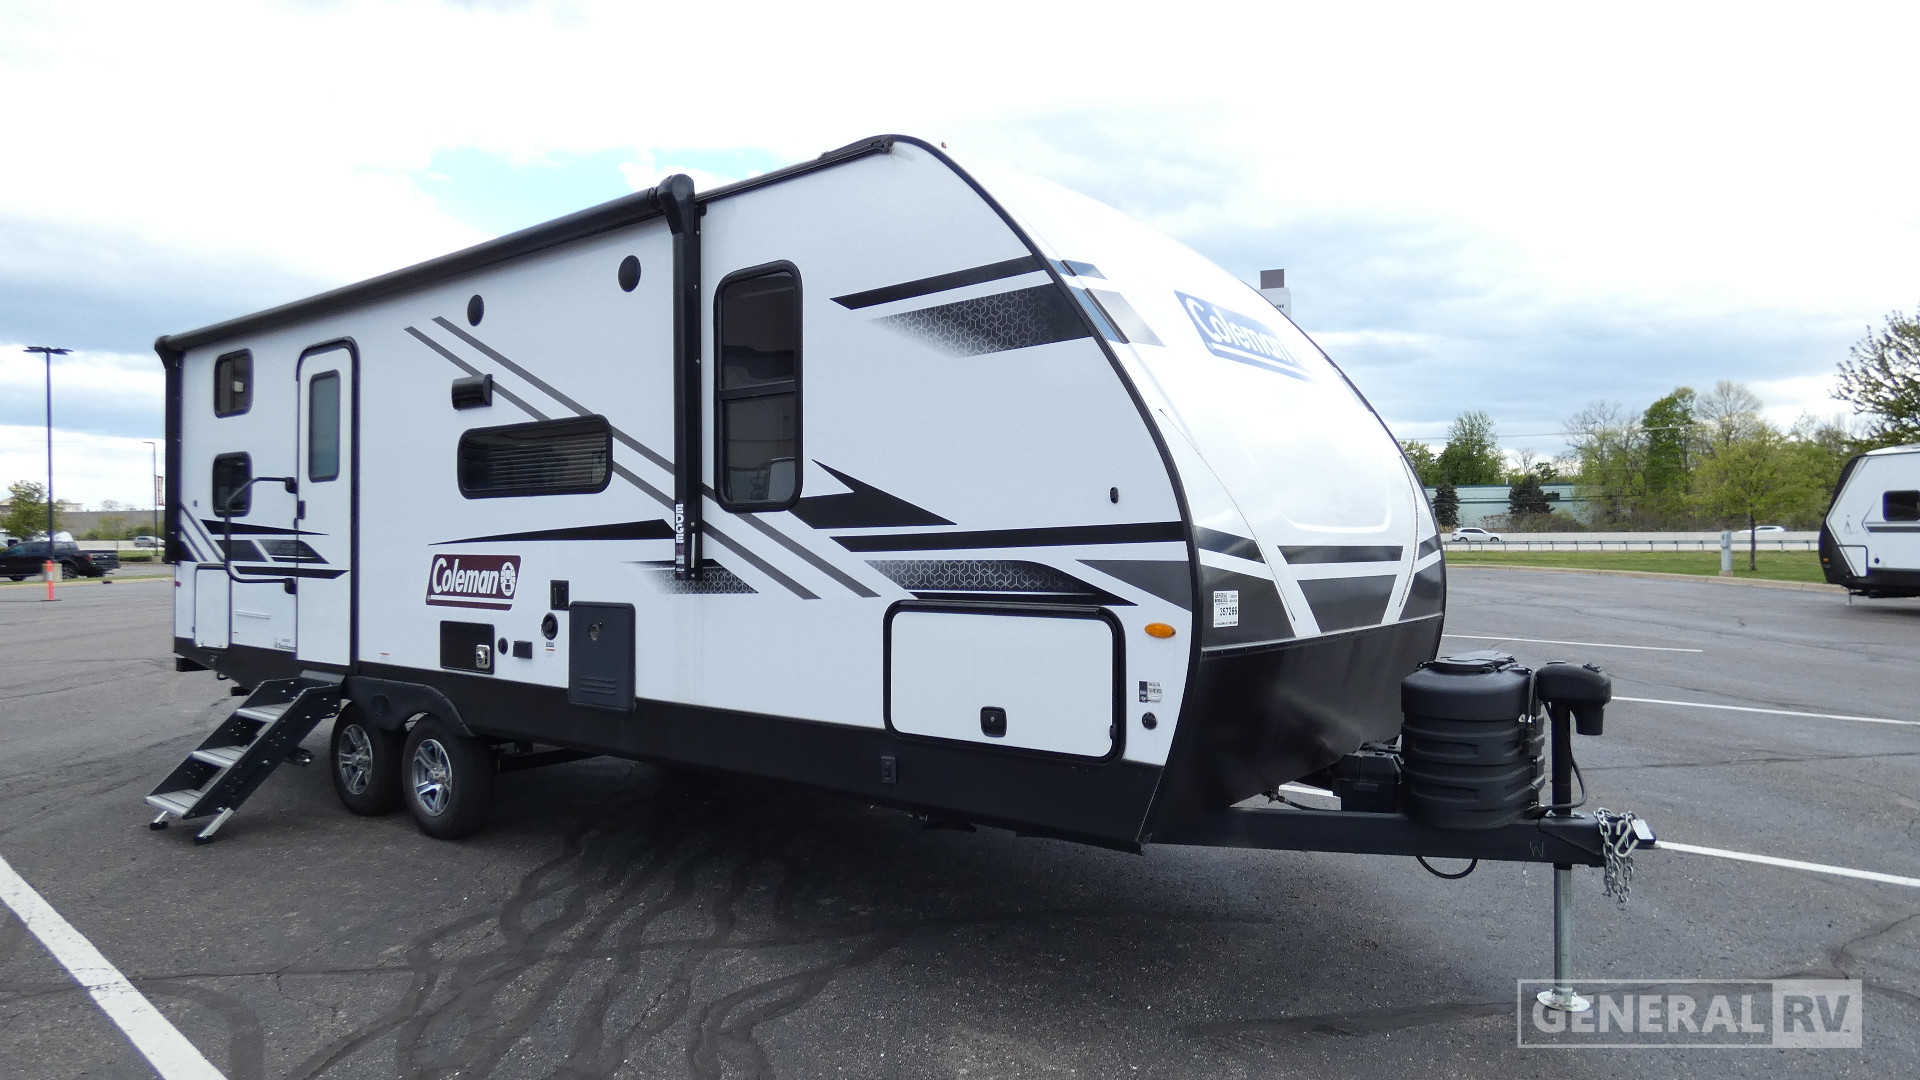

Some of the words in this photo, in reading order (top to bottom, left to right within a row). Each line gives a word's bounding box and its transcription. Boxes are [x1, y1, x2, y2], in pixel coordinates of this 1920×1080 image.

[1185, 297, 1295, 364] Coleman
[675, 503, 685, 544] EDGE
[432, 557, 500, 595] Coleman
